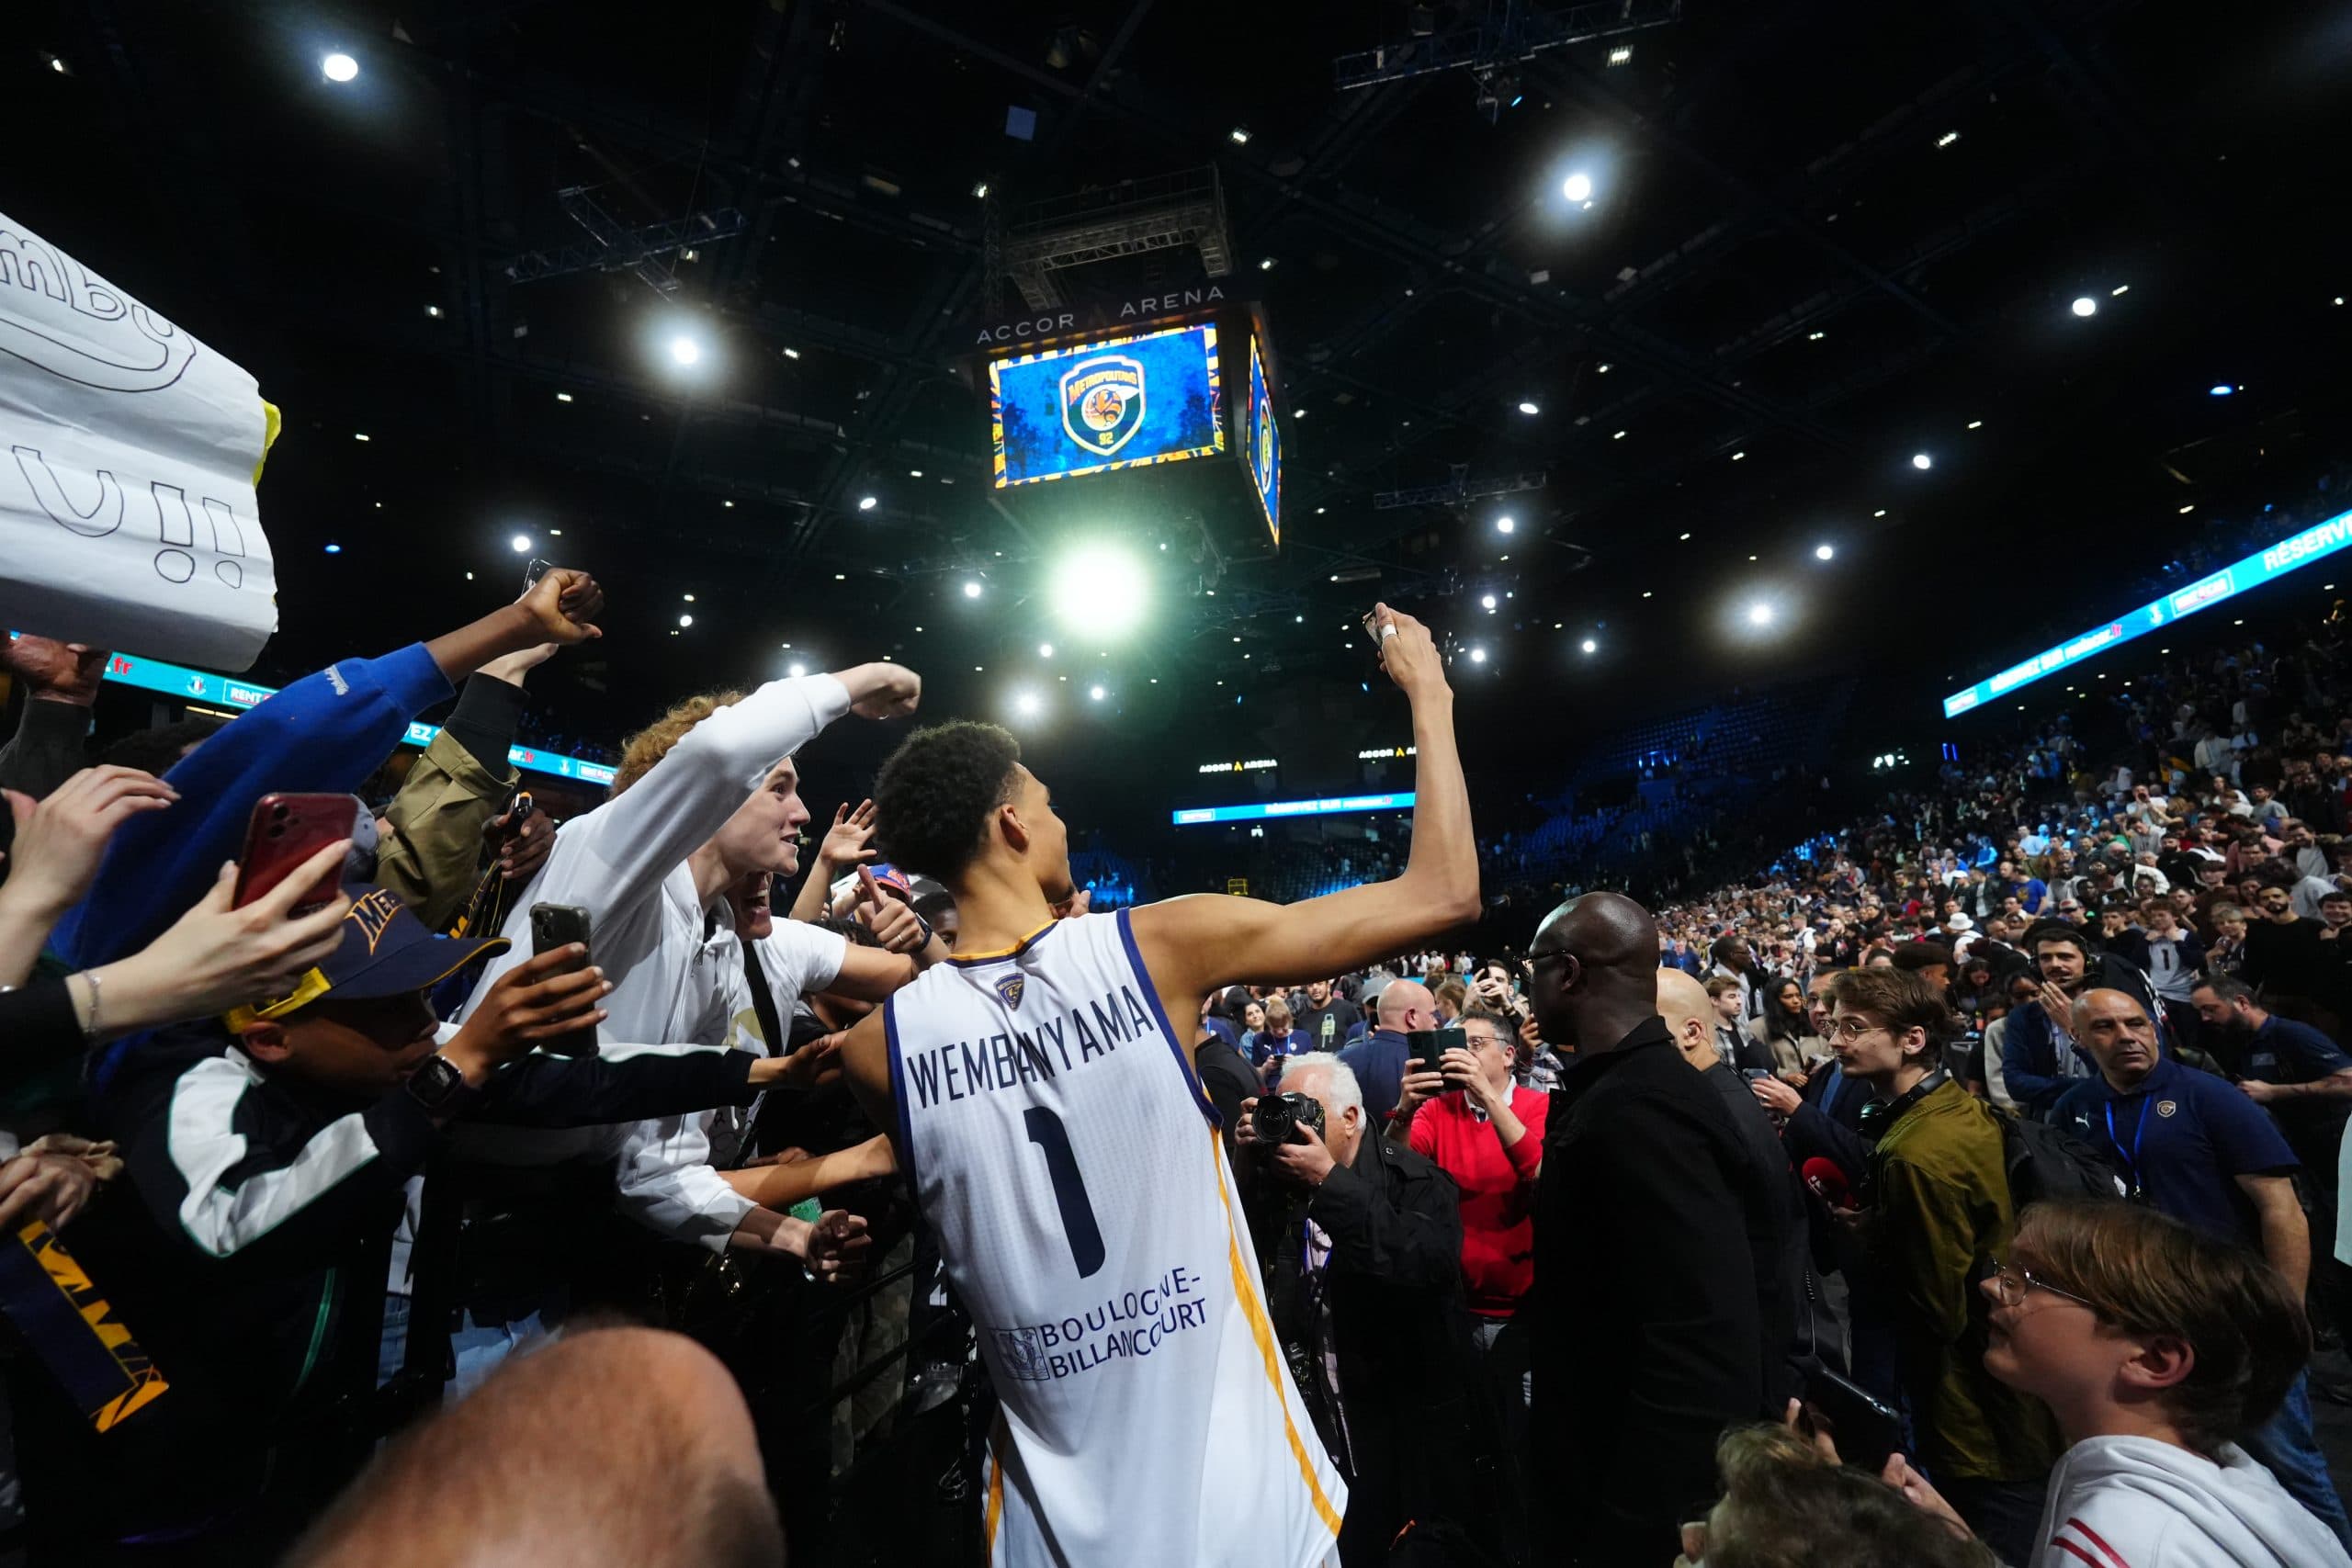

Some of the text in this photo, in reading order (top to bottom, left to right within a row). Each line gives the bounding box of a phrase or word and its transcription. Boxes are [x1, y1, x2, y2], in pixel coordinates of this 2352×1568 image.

[976, 286, 1224, 344] ACCOR ARENA
[906, 985, 1155, 1109] WEMBANYAMA
[1023, 1105, 1106, 1279] 1
[1039, 1267, 1201, 1348] BOULOGNE-
[1048, 1297, 1206, 1379] BILLANCOURT
